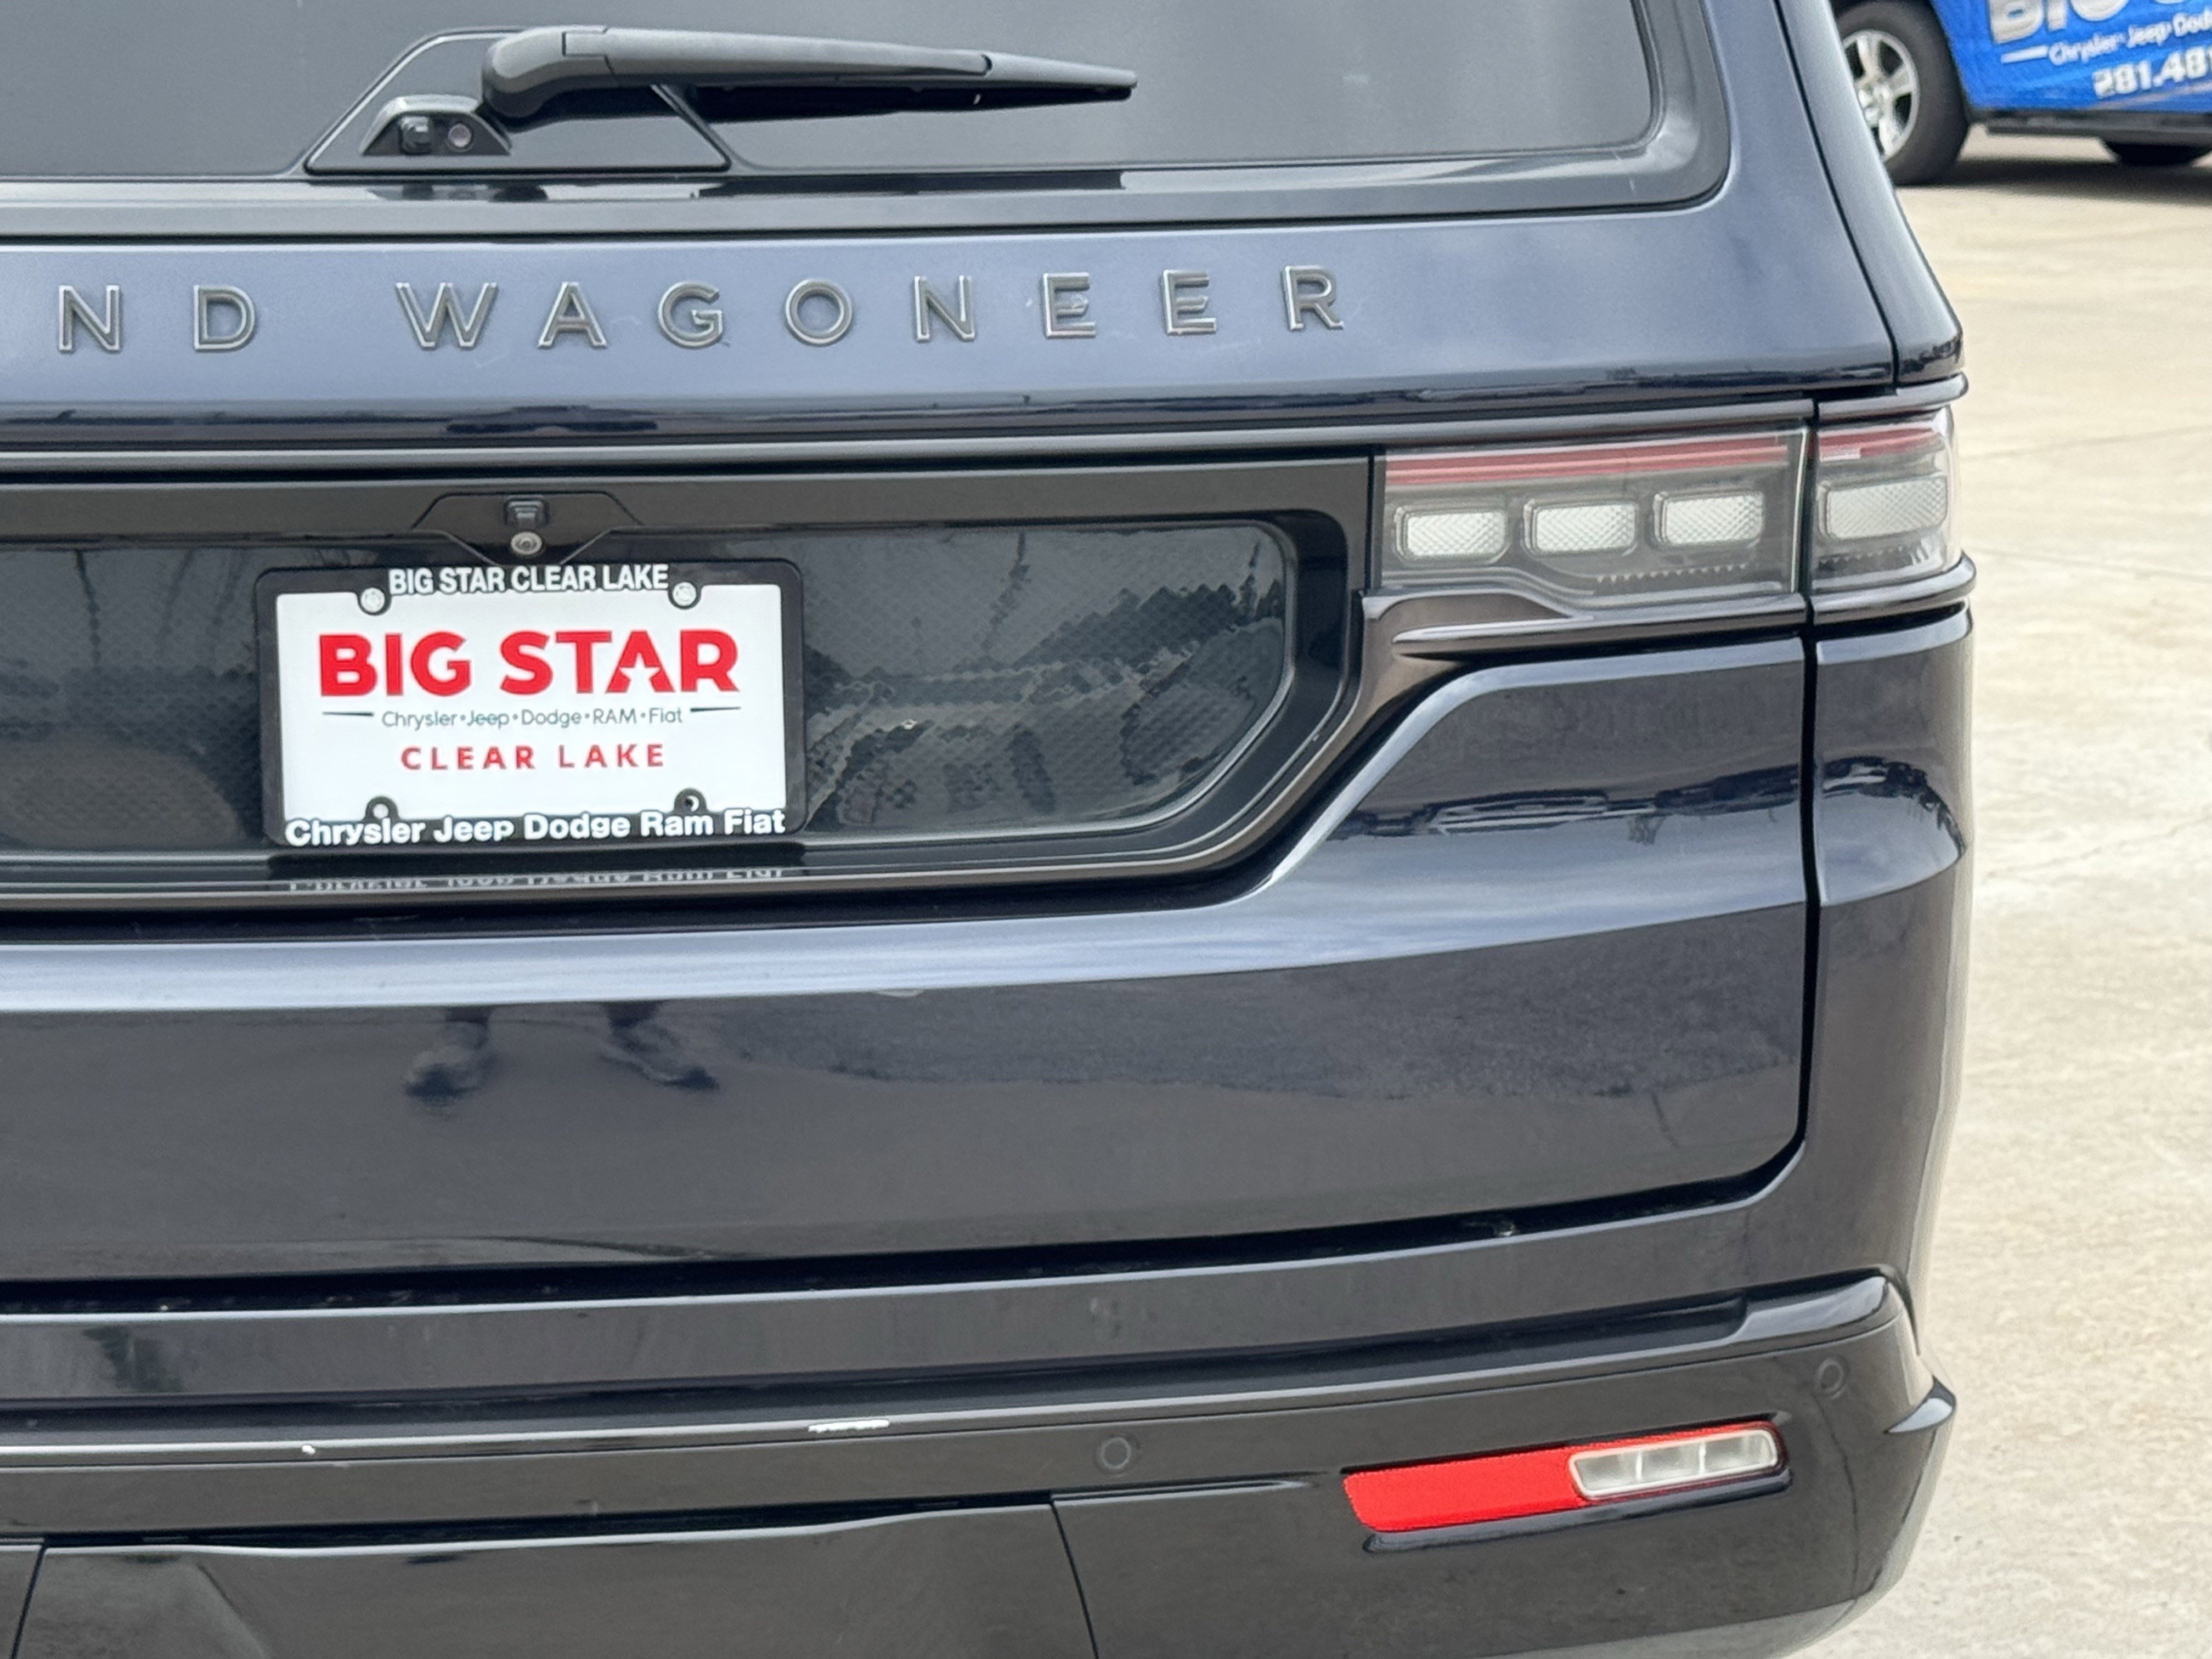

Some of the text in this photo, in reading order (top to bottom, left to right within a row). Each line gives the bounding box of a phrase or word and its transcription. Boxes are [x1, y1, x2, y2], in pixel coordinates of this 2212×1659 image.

[395, 264, 1344, 349] WAGONEER
[388, 563, 669, 595] BIG STAR CLEAR LAKE
[319, 629, 740, 697] BIG STAR
[381, 707, 683, 731] Chrysler Jeep Dodge RAM Fiat
[400, 744, 664, 770] CLEAR LAKE
[285, 808, 786, 847] Chrysler Jeep Dodge Ram Fiat
